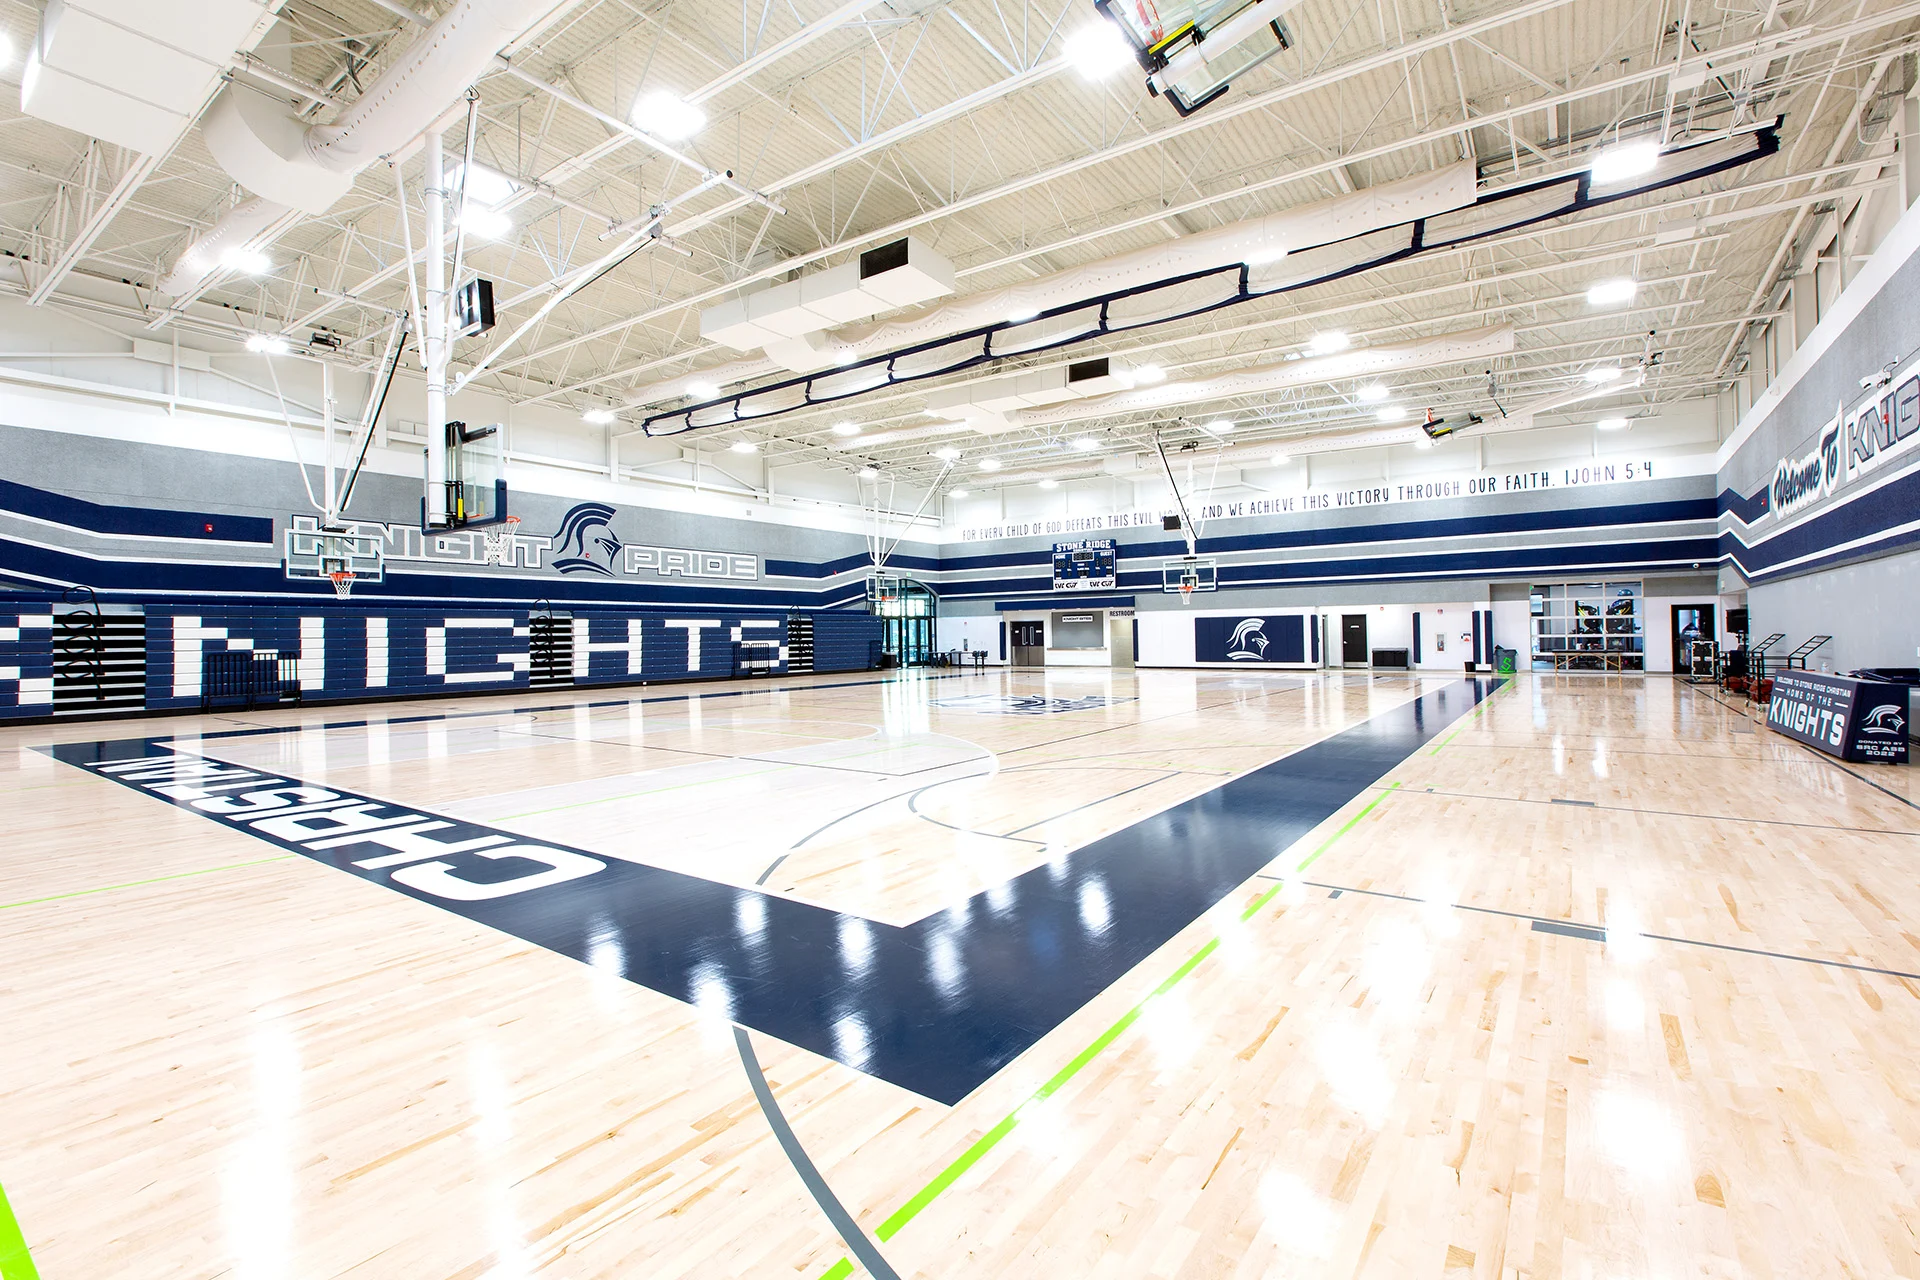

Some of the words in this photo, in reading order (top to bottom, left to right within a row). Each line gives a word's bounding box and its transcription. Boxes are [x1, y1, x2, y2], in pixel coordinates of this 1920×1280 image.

[1773, 457, 1822, 511] Welcome
[1821, 419, 1840, 486] To
[1847, 374, 1920, 471] KNIG
[963, 529, 977, 541] FOR
[980, 527, 1003, 539] EVERY
[1006, 524, 1029, 537] CHILD
[1033, 522, 1042, 535] OF
[1046, 520, 1062, 533] GOD
[1066, 516, 1102, 531] DEFEATS
[1108, 514, 1129, 527] THIS
[1133, 511, 1153, 525] EVIL
[1202, 504, 1223, 518] AND
[1229, 502, 1243, 516] WE
[1250, 497, 1294, 514] ACHIEVE
[1302, 493, 1329, 510] THIS
[1336, 487, 1389, 506] VICTORY
[1397, 480, 1460, 501] THROUGH
[1469, 476, 1497, 495] OUR
[1506, 471, 1556, 491] FAITH.
[1625, 461, 1653, 480] 5:4
[623, 543, 758, 581] PRIDE
[1056, 541, 1084, 552] STONE
[1085, 539, 1111, 549] RIDGE
[1776, 676, 1794, 686] WELCOME
[1794, 679, 1800, 687] TO
[1800, 681, 1813, 690] STONE
[1813, 683, 1826, 693] RIDGE
[1826, 684, 1852, 698] CHRISTIAN
[1786, 688, 1804, 700] HOME
[1806, 691, 1815, 702] OF
[1818, 695, 1833, 707] THE
[1769, 696, 1846, 747] KNIGHTS
[83, 754, 608, 901] CHRISTIAN
